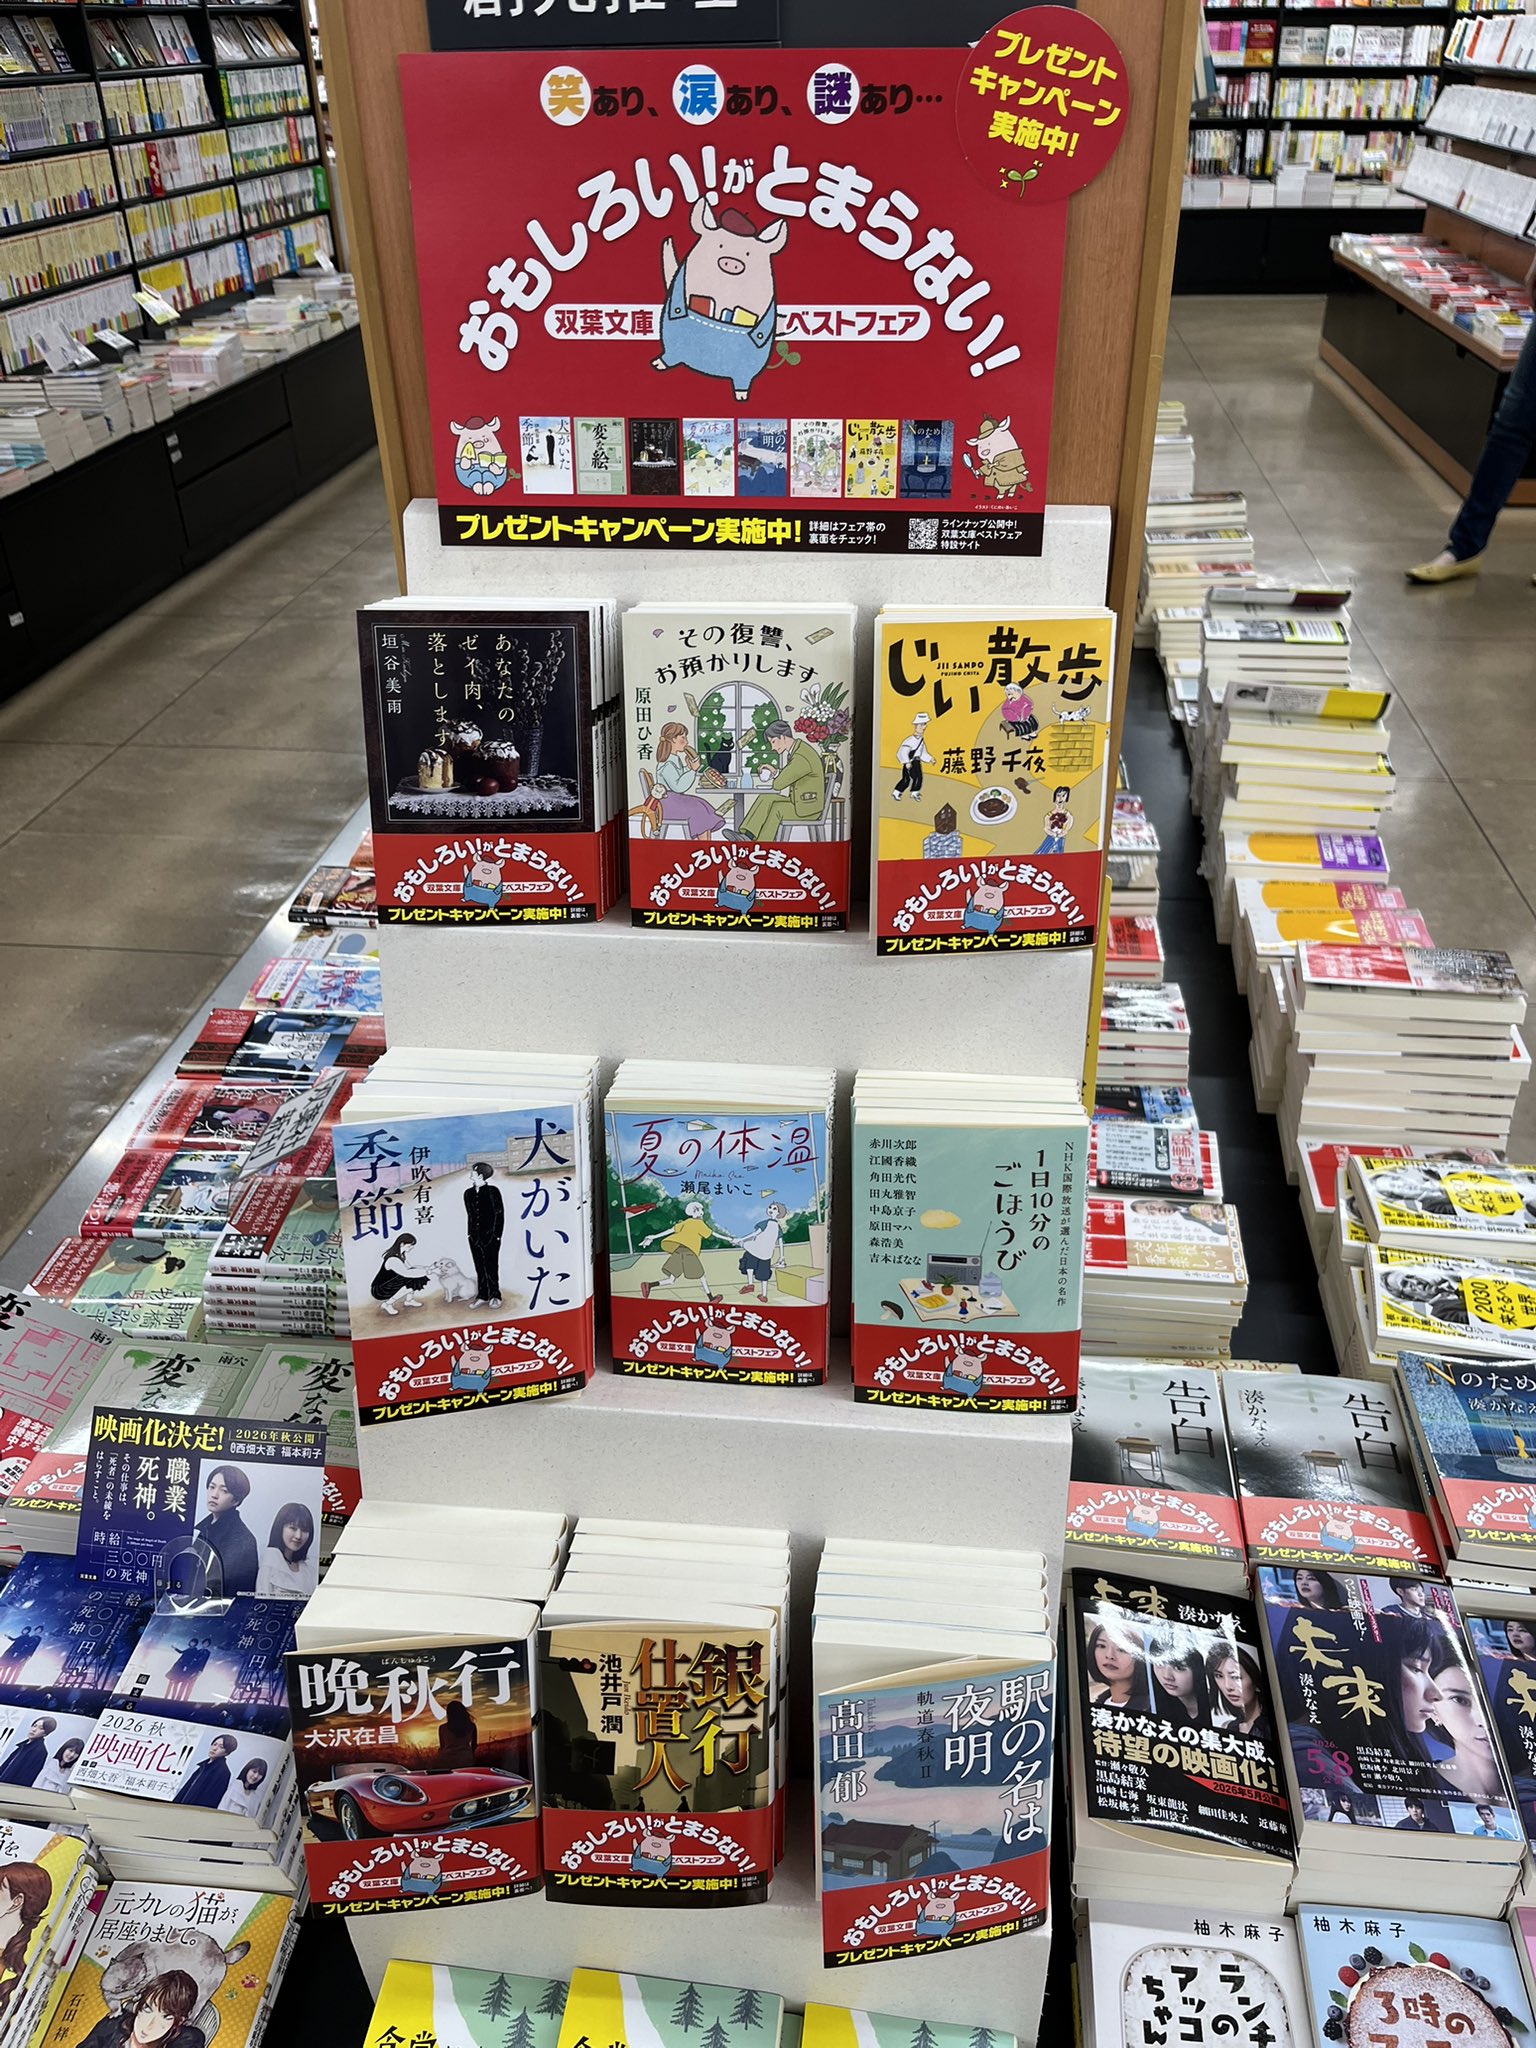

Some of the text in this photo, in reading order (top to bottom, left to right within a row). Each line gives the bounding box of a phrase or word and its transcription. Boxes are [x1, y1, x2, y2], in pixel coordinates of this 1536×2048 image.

[993, 29, 1118, 82] プレゼント
[969, 66, 1121, 127] キャンペーン
[988, 111, 1080, 157] 実施中!
[555, 308, 654, 335] 双葉文庫
[787, 310, 920, 335] ベストフェア
[456, 513, 801, 544] プレゼントキャンペーン実施中!
[809, 521, 886, 532] 詳細はフェア帯の
[809, 533, 876, 544] 裏面をチェック!
[941, 530, 1022, 539] 双葉文庫ベストフェア
[942, 519, 1018, 529] ラインナップ公開中!
[941, 540, 980, 550] 特設サイト
[382, 634, 401, 714] 垣谷美雨
[462, 635, 483, 709] ゼイ肉、
[495, 633, 514, 722] あなたの
[654, 653, 818, 686] お預かりします
[888, 625, 1102, 719] じい散歩
[952, 661, 984, 669] SANPO
[427, 632, 450, 748] 落とします
[635, 687, 653, 760] 原田ひ香
[940, 746, 1046, 774] 藤野千夜
[387, 906, 567, 921] プレゼントキャンペーン実施中!
[643, 911, 819, 928] プレゼントキャンペーン実施中!
[885, 932, 1066, 953] プレゼントキャンペーン実施中!
[621, 1117, 820, 1184] 夏の体温
[869, 1138, 917, 1150] 赤川次郎
[869, 1155, 917, 1167] 江國香織
[343, 1129, 404, 1241] 季節
[408, 1146, 434, 1224] 伊吹有喜
[680, 1180, 752, 1196] 瀬尾まいこ
[869, 1172, 916, 1184] 角田光代
[869, 1188, 916, 1200] 田丸雅智
[514, 1118, 571, 1310] 犬がいた
[869, 1205, 916, 1217] 中島京子
[993, 1162, 1027, 1271] ごほうび
[1029, 1150, 1052, 1251] 1日10分の
[869, 1221, 912, 1232] 原田マハ
[1057, 1141, 1074, 1306] NHK国際放送が選んだ日本の名作
[869, 1237, 903, 1248] 森浩美
[869, 1253, 921, 1266] 吉本ばなな
[218, 1354, 249, 1367] 雨穴
[623, 1362, 794, 1384] プレゼントキャンペーン実施中!
[372, 1381, 557, 1420] プレゼントキャンペーン実施中!
[866, 1389, 1047, 1412] プレゼントキャンペーン実施中!
[94, 1414, 225, 1451] 映画化決定!
[1162, 1380, 1215, 1458] 告白
[1244, 1389, 1272, 1448] 湊かなえ
[1343, 1393, 1402, 1474] 告白
[236, 1429, 315, 1443] 2026年秋公開
[236, 1443, 322, 1459] 西畑大吾 福本莉子
[93, 1451, 104, 1503] はらすこと。
[103, 1452, 118, 1520] 「死者」の未練を
[119, 1453, 131, 1506] その仕事は、
[133, 1456, 160, 1520] 死神。
[163, 1457, 190, 1522] 職業、
[94, 1531, 120, 1546] 時給
[106, 1568, 148, 1584] の死神
[298, 1646, 520, 1724] 晩秋行
[599, 1653, 623, 1734] 池井戸潤
[1299, 1672, 1322, 1725] 湊かなえ
[631, 1638, 691, 1793] 仕置人
[688, 1640, 768, 1776] 銀行
[101, 1714, 166, 1737] 2026 秋
[304, 1726, 399, 1749] 大沢在昌
[942, 1683, 996, 1779] 夜明
[1090, 1707, 1275, 1766] 湊かなえの集大成、
[999, 1669, 1050, 1845] 駅の名は
[1092, 1729, 1280, 1794] 待望の映画化!
[1096, 1769, 1147, 1790] 黒島結菜
[1213, 1782, 1281, 1807] 2026年5月公開
[1148, 1807, 1189, 1824] 北川景子
[554, 1873, 738, 1890] プレゼントキャンペーン実施中!
[105, 1890, 239, 1925] 元カレの猫が、
[322, 1886, 510, 1915] プレゼントキャンペーン実施中!
[95, 1918, 197, 1947] 居座りまして。
[1194, 1919, 1285, 1942] 柚木麻子
[1313, 1916, 1406, 1939] 柚木麻子
[53, 1993, 85, 2043] 石田祥
[1141, 1975, 1172, 2047] ちゃん
[1373, 1990, 1476, 2035] 3時の
